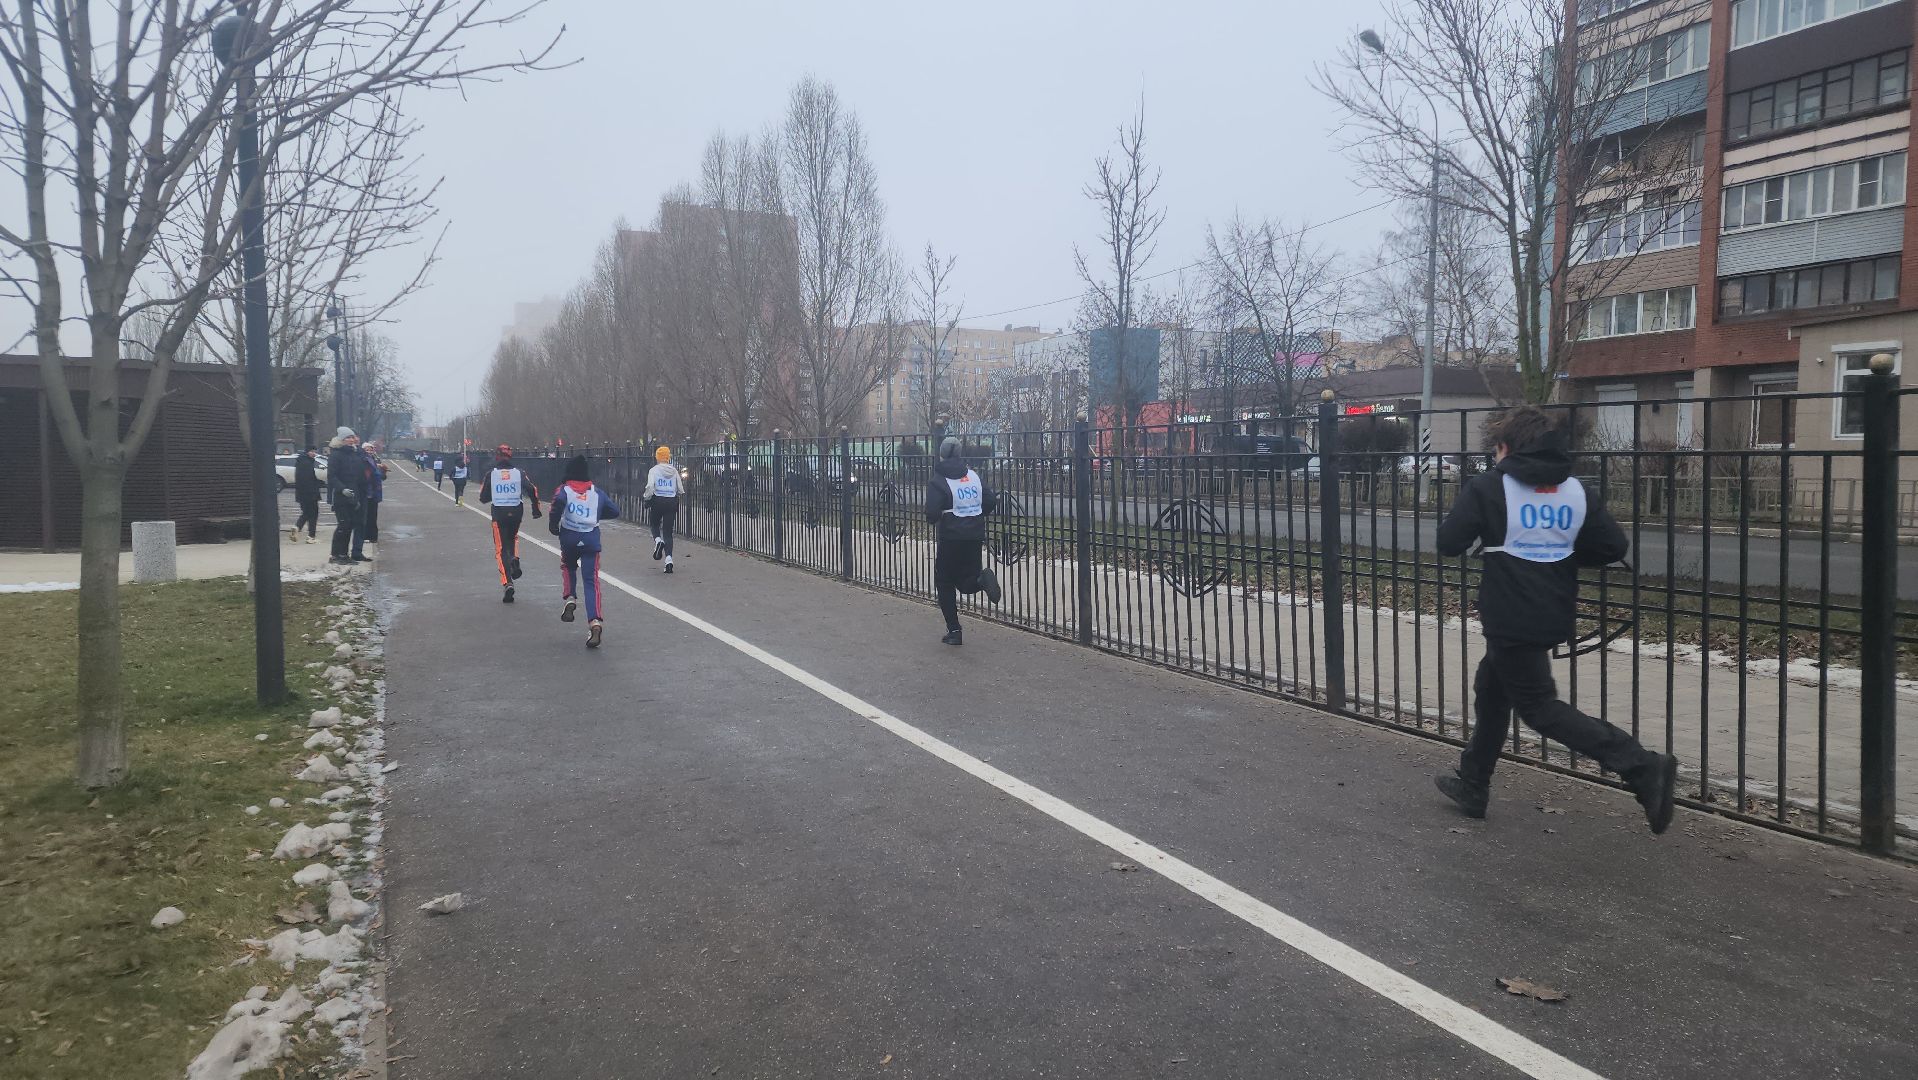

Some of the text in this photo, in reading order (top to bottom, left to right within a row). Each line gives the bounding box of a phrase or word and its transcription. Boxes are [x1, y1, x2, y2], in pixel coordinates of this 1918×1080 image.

[496, 483, 517, 493] 068
[957, 486, 979, 500] 088
[568, 502, 590, 518] 081
[1520, 503, 1573, 530] 090
